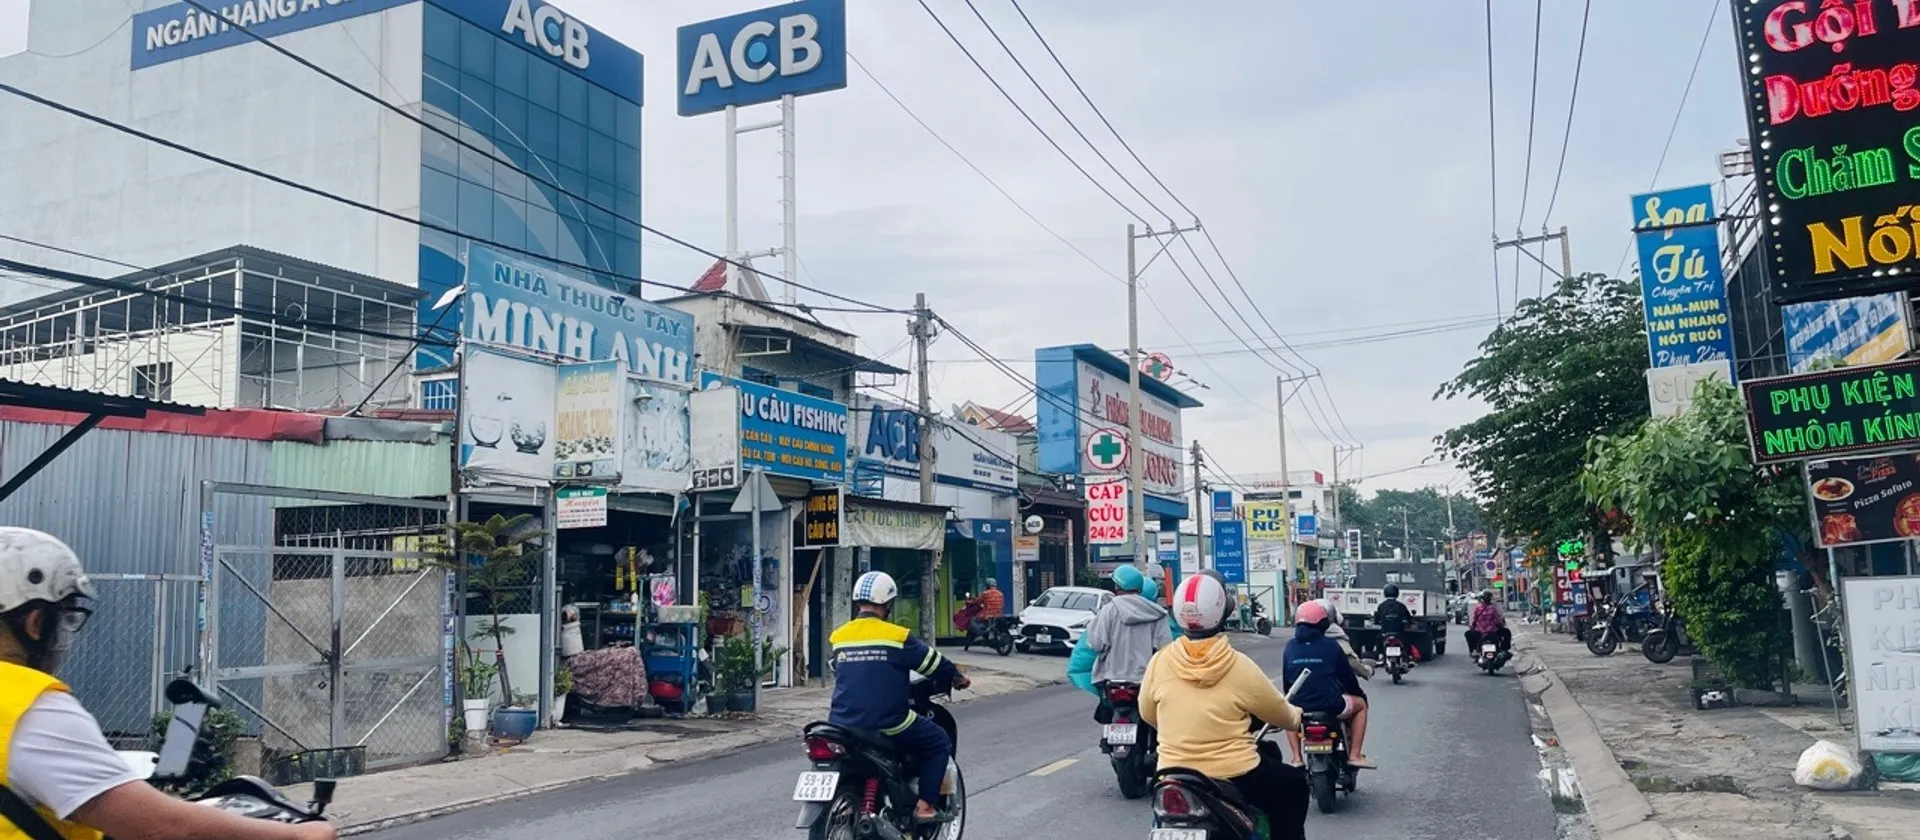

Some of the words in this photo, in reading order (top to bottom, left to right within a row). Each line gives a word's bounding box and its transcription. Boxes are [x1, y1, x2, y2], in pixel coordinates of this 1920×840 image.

[147, 8, 217, 50] NGÂN
[501, 0, 590, 69] ACB
[685, 13, 823, 96] ACB
[1764, 63, 1920, 125] Dưỡng
[1776, 144, 1896, 199] Chăm
[1638, 197, 1707, 240] Spa
[1652, 244, 1709, 283] Tú
[494, 261, 549, 297] NHÀ
[643, 309, 681, 338] TÂY
[471, 292, 596, 361] MINH
[609, 331, 688, 383] ANH
[1679, 313, 1727, 330] NHANG
[758, 392, 791, 424] CÂU
[793, 404, 849, 435] FISHING
[1770, 384, 1830, 415] PHỤ
[1841, 371, 1916, 406] KIỆN
[1764, 419, 1853, 455] NHÔM
[1089, 503, 1124, 522] CỨU
[1253, 509, 1279, 519] PU
[1854, 494, 1880, 510] Pizza
[1090, 525, 1124, 539] 24/24
[1253, 521, 1280, 531] NC
